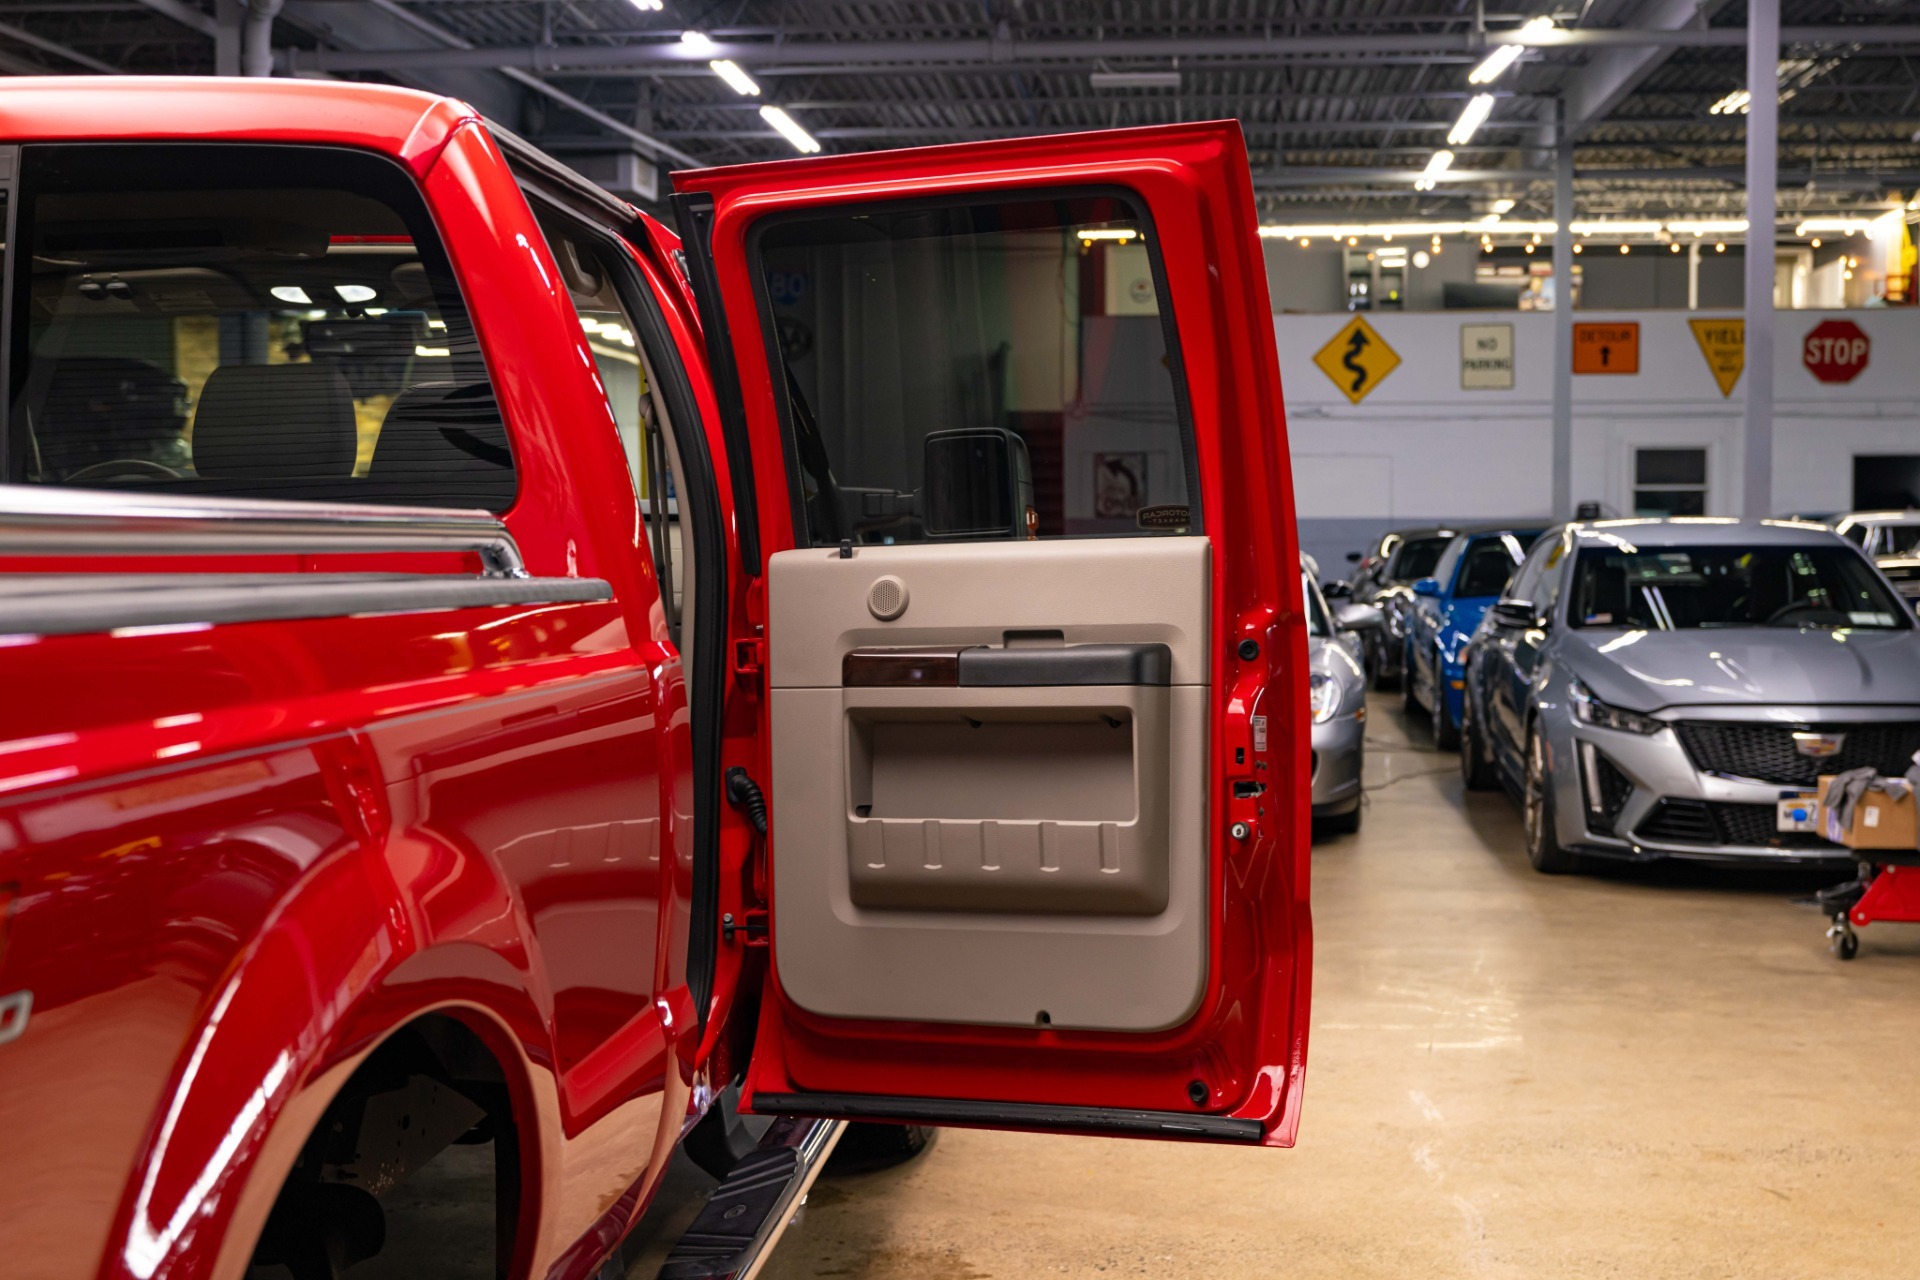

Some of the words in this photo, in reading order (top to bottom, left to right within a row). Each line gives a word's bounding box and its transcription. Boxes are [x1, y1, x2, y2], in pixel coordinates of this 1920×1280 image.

[1579, 329, 1632, 343] DETOUR
[1703, 329, 1744, 344] YIEL
[1476, 337, 1498, 351] NO
[1805, 337, 1866, 365] STOP
[1463, 358, 1512, 371] PARKING
